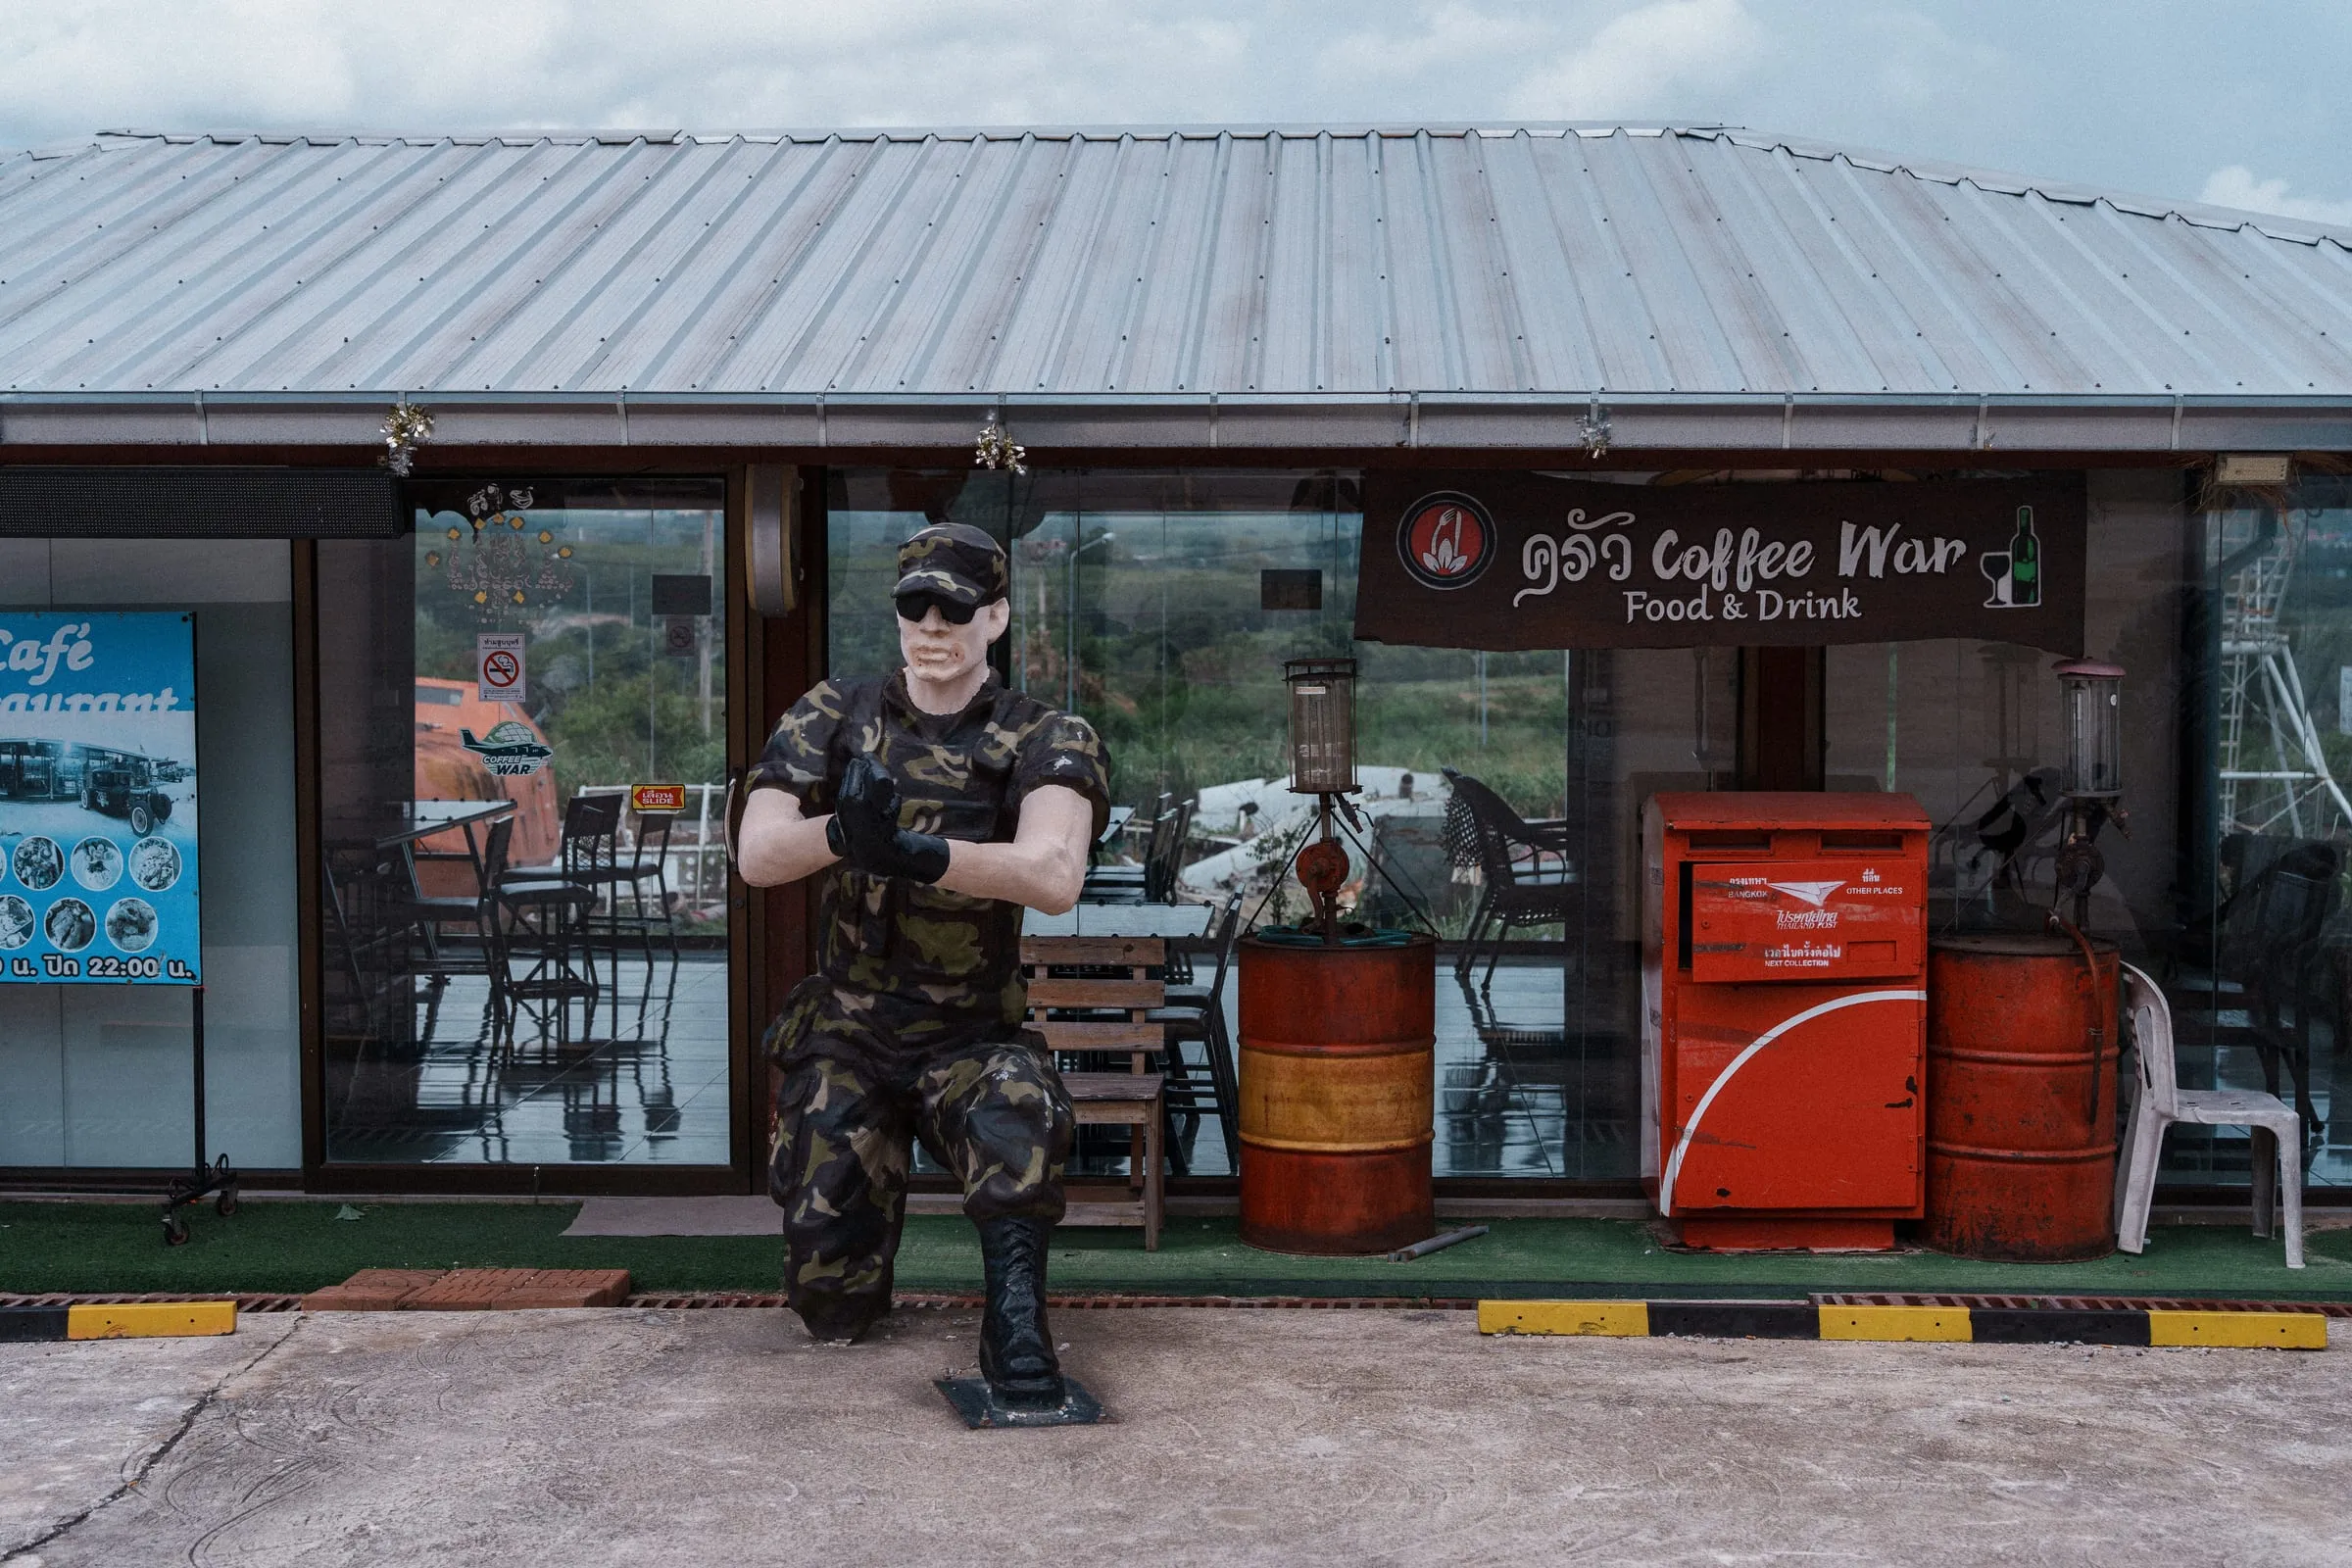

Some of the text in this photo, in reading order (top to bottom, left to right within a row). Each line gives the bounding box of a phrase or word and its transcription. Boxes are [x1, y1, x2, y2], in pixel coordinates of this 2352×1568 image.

[1652, 527, 1816, 592] Coffee
[1838, 520, 1967, 578] War
[1622, 583, 1862, 624] Food & Drink
[0, 687, 179, 714] aurant
[483, 756, 521, 764] COFFEE
[496, 764, 531, 775] WAR
[1728, 890, 1768, 899] BANGKOK
[88, 956, 158, 977] 22:00
